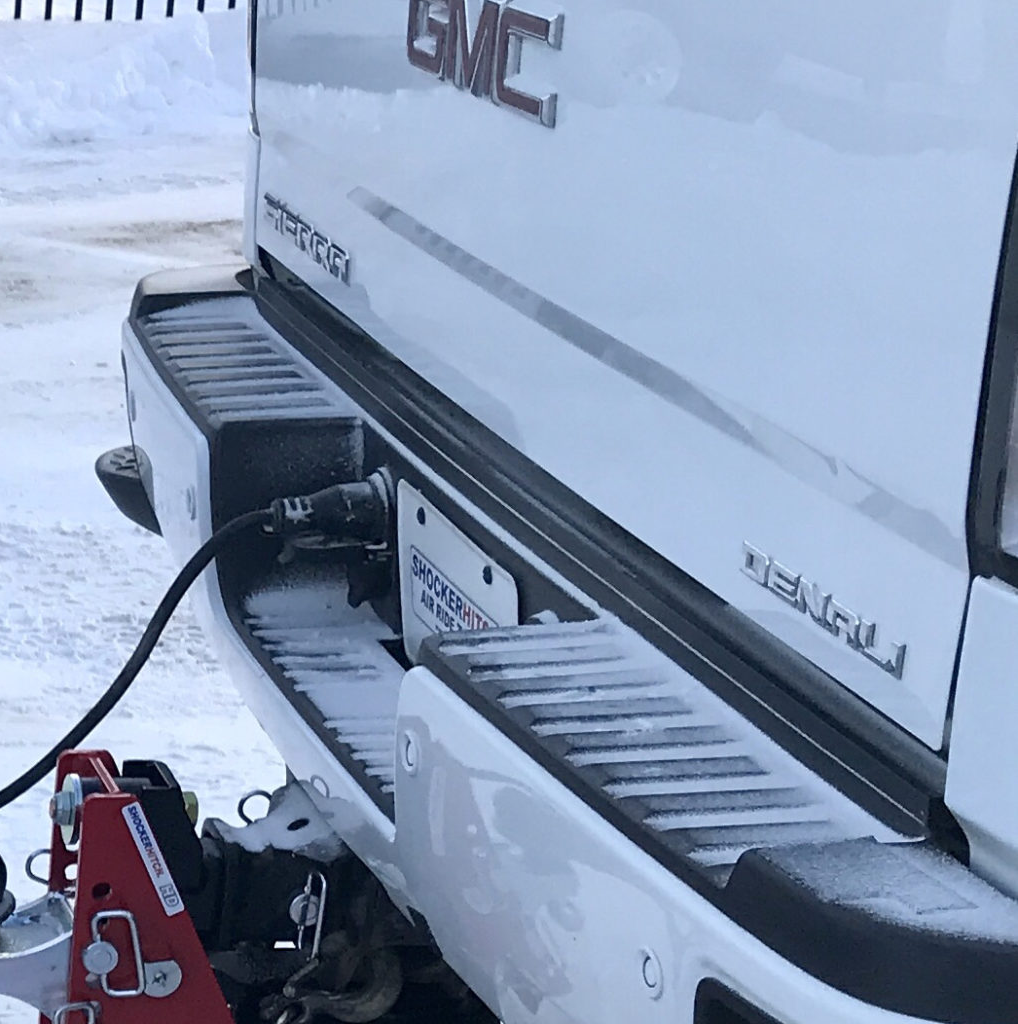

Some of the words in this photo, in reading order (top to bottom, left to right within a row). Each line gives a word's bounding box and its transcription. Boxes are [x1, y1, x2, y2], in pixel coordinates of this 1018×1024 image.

[407, 0, 565, 129] GMC
[264, 191, 351, 288] SIERRA
[421, 590, 434, 614] AIR
[436, 603, 455, 631] RIDE
[739, 540, 907, 680] DENALI
